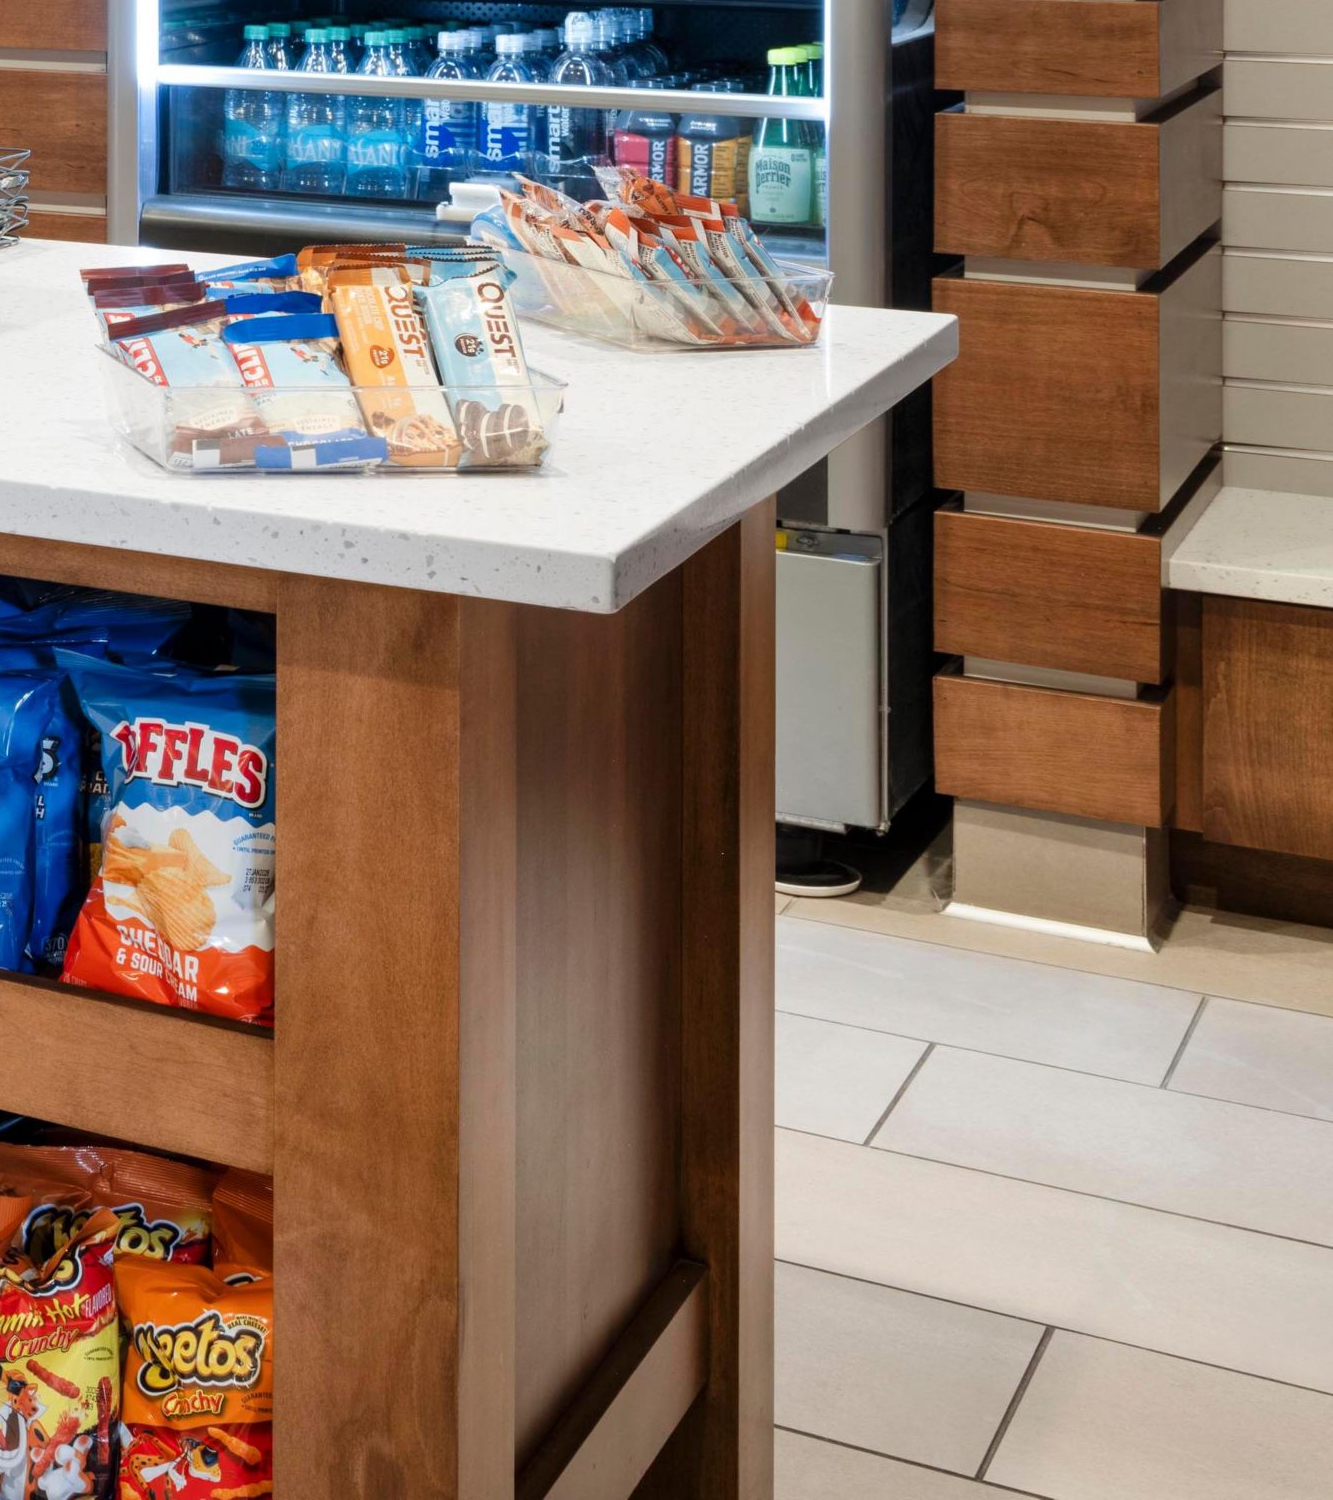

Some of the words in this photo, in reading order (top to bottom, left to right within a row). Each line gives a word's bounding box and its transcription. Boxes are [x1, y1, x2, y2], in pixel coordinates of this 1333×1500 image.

[425, 99, 439, 159] smar
[487, 100, 502, 162] smar
[755, 160, 791, 177] Maison
[755, 173, 792, 189] Perrier
[385, 286, 425, 359] QUEST
[477, 282, 517, 359] QUEST
[233, 832, 270, 846] GUARANTEED
[116, 947, 128, 965] &
[130, 952, 164, 979] SOUR
[47, 1293, 90, 1324] Hot
[84, 1283, 112, 1319] FLAVORED
[5, 1326, 80, 1364] Crunchy
